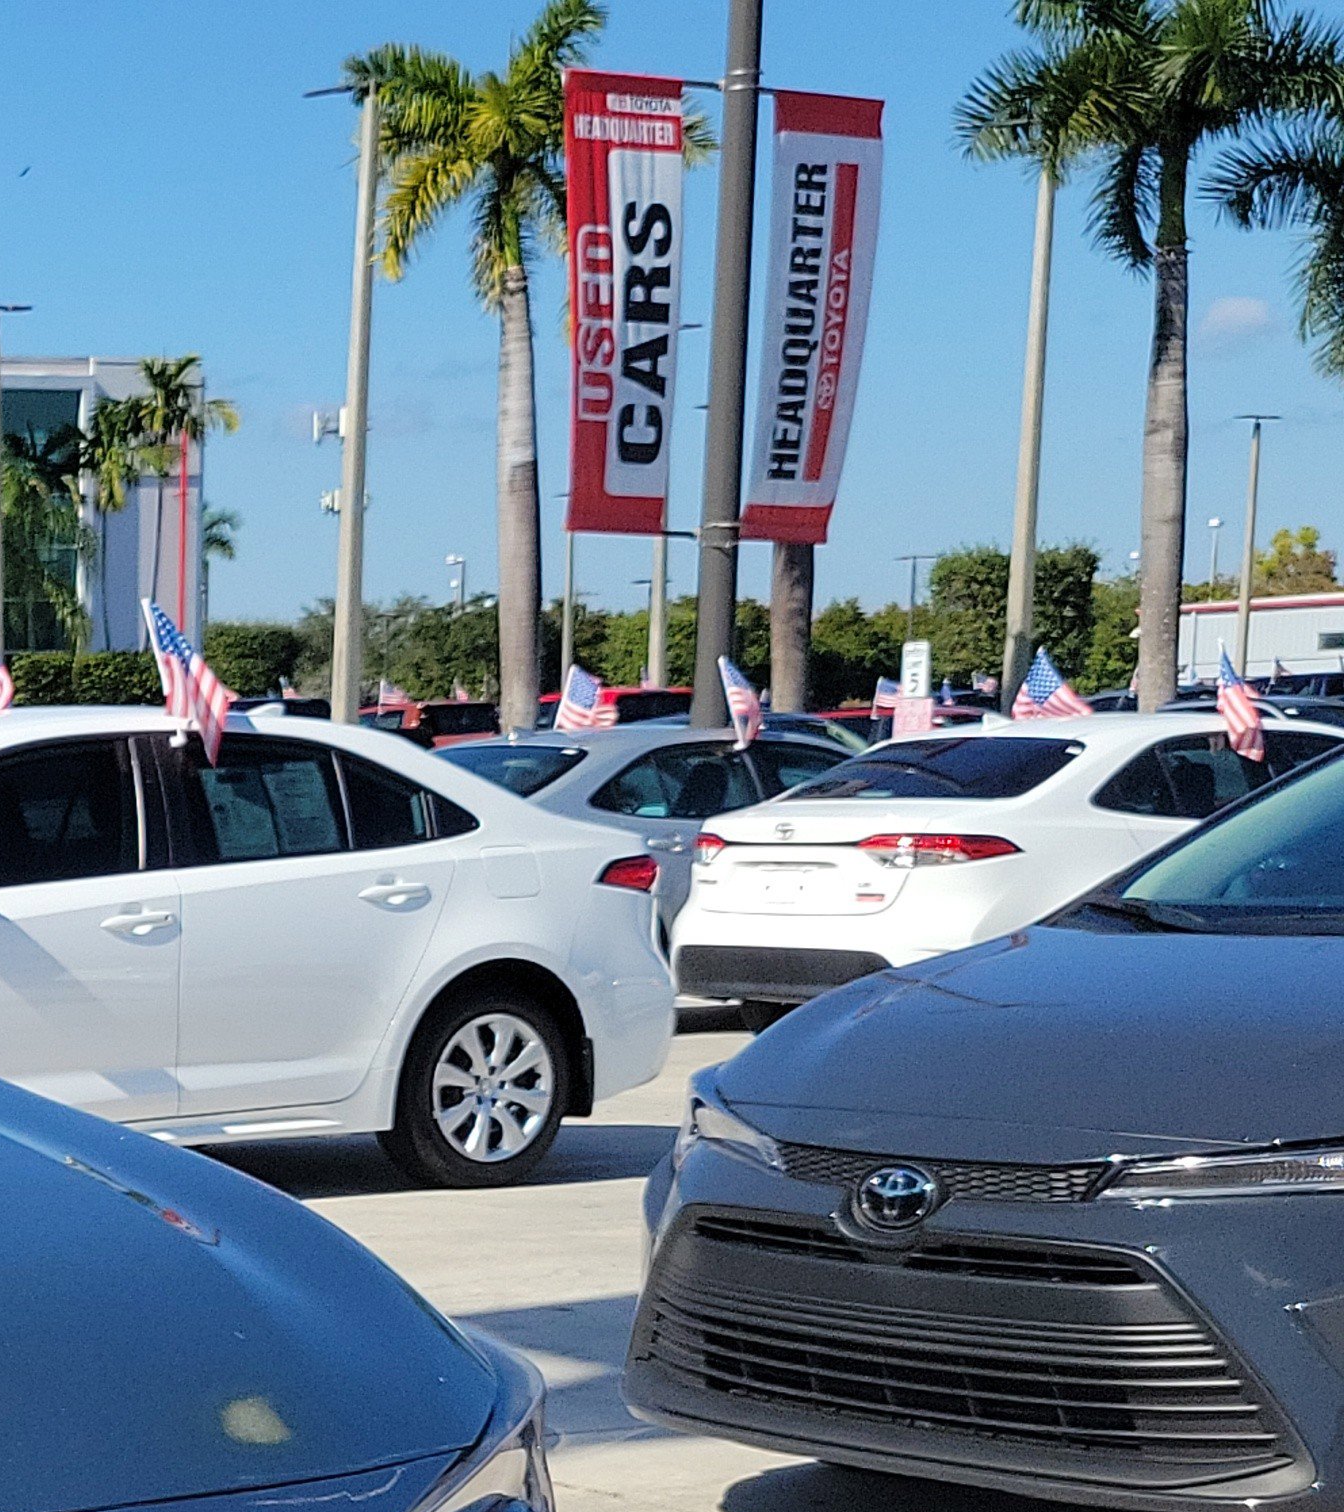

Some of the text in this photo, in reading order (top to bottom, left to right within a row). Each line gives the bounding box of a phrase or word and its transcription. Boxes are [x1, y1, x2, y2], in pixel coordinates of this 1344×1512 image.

[573, 114, 675, 146] HEADQUARTER
[576, 223, 616, 422] USED
[617, 201, 673, 464] CARS
[766, 162, 828, 481] HEADQUARTER
[822, 249, 850, 365] TOYOTA
